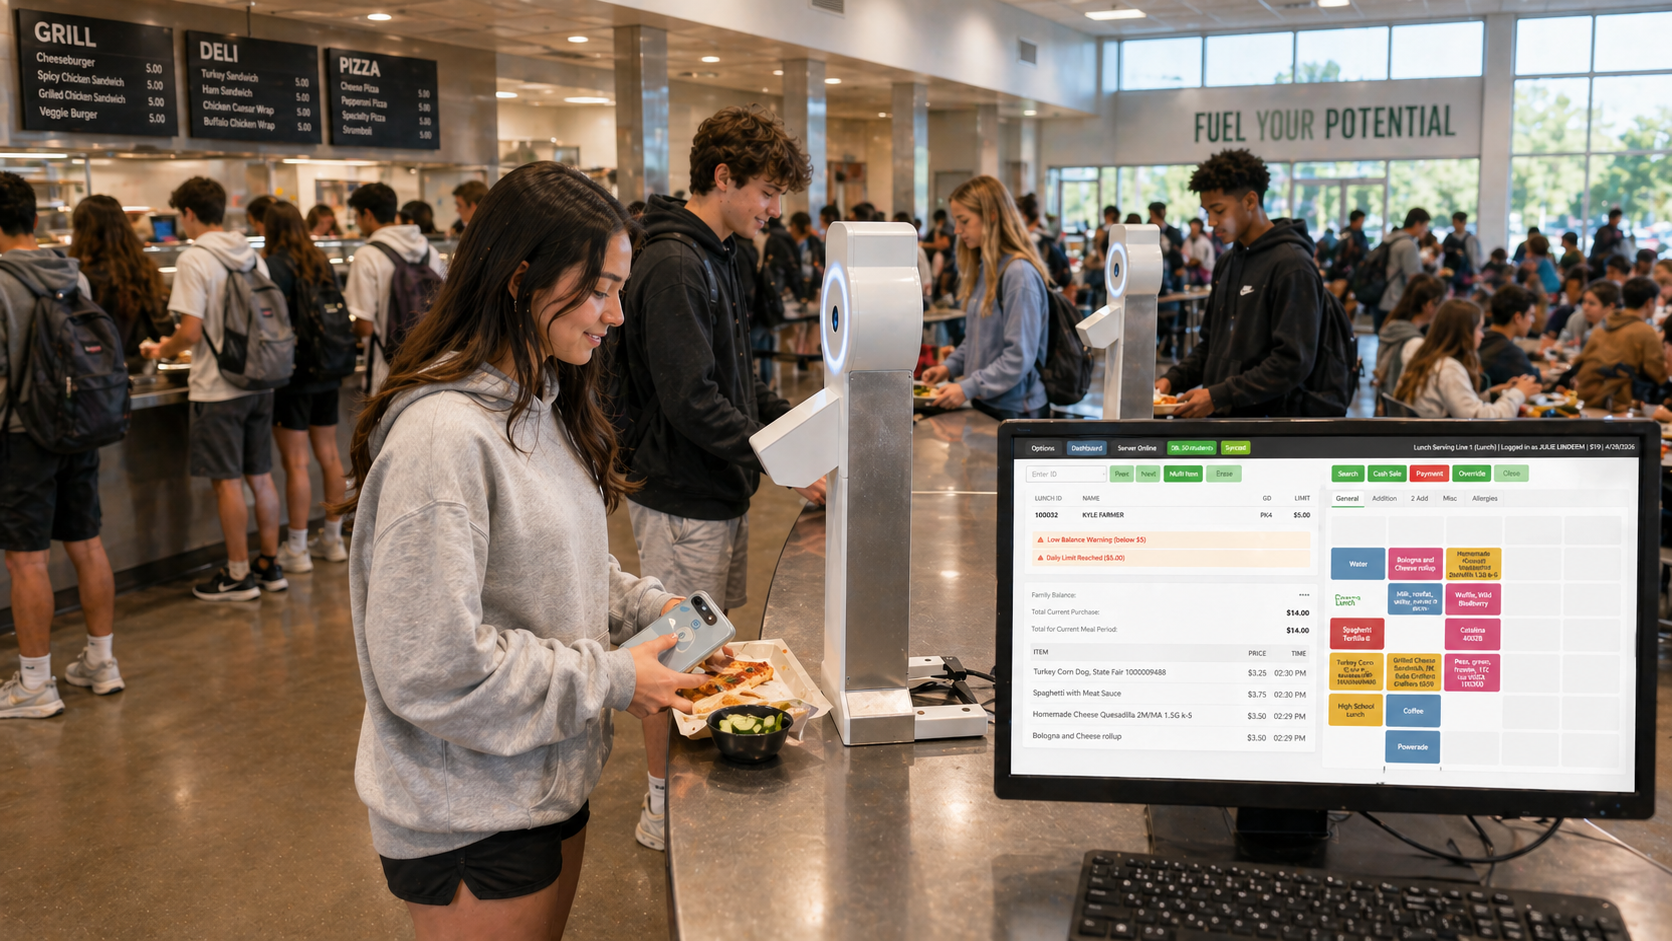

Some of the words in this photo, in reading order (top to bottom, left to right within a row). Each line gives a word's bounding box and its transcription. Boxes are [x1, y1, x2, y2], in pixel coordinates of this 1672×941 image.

[34, 21, 96, 47] GRILL
[200, 41, 238, 63] DELI
[36, 52, 96, 69] Cheeseburger
[146, 63, 162, 74] 5.00
[340, 56, 381, 77] PIZZA
[38, 70, 60, 83] Spicy
[61, 72, 91, 84] Chicken
[92, 75, 125, 87] Sandwich
[147, 80, 163, 91] 5.00
[295, 77, 309, 88] 5.00
[38, 88, 64, 100] Grilled
[65, 90, 92, 102] Chicken
[94, 93, 126, 104] Sandwich
[148, 97, 165, 107] 5.00
[202, 84, 219, 95] Ham
[220, 86, 253, 98] Sandwich
[296, 93, 310, 102] 5.00
[418, 89, 430, 99] 5.00
[256, 105, 275, 117] Wrap
[297, 108, 311, 117] 5.00
[418, 103, 431, 112] 5.00
[39, 106, 69, 120] Veggie
[71, 108, 98, 121] Burger
[149, 114, 165, 124] 5.00
[257, 120, 275, 131] Wrap
[297, 122, 312, 132] 5.00
[1195, 111, 1246, 143] FUEL
[1256, 109, 1315, 142] YOUR
[1325, 104, 1456, 140] POTENTIAL
[419, 131, 432, 140] 5.00
[1433, 444, 1455, 452] Serving
[1472, 495, 1498, 504] Allergies
[1114, 536, 1135, 544] (below
[1136, 536, 1147, 544] $5)
[1032, 592, 1050, 600] Family
[1286, 609, 1310, 617] $14.00
[1286, 627, 1310, 635] $14.00
[1034, 668, 1056, 677] Turkey
[1076, 669, 1091, 678] Dog,
[1248, 669, 1267, 678] $3.25
[1033, 690, 1065, 698] Spaghetti
[1248, 691, 1267, 699] $3.75
[1100, 711, 1136, 719] Quesadilla
[1137, 711, 1163, 719] 2M/MA
[1247, 712, 1267, 721] $3.50
[1274, 712, 1293, 720] 02:29
[1294, 712, 1306, 720] PM
[1032, 732, 1060, 741] Bologna
[1102, 733, 1122, 741] rollup
[1247, 734, 1267, 742] $3.50
[1274, 734, 1292, 742] 02:29
[1294, 734, 1306, 742] PM
